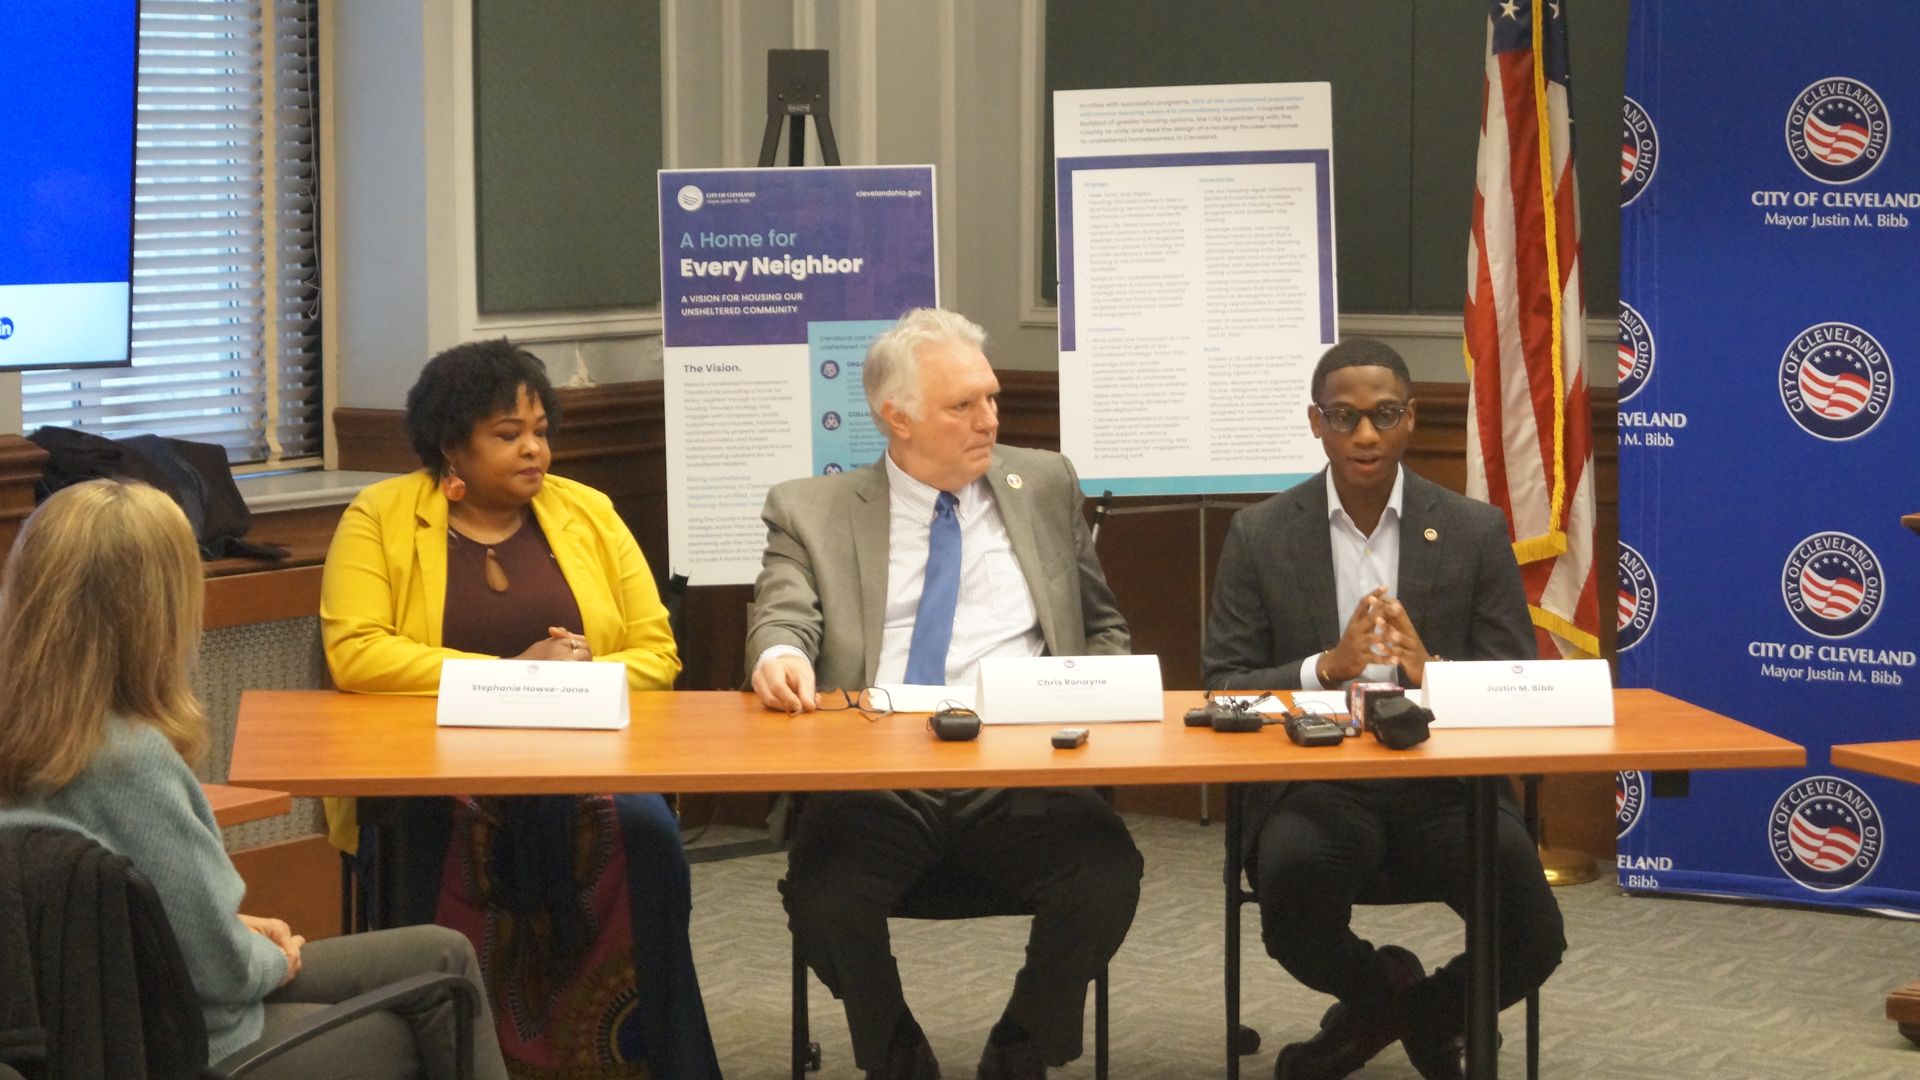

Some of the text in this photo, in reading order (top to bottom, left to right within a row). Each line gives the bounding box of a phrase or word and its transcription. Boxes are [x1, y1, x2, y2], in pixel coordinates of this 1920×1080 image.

[1791, 82, 1884, 160] CITY OF CLEVELAND OHIO
[1634, 139, 1653, 182] OHIO
[1751, 191, 1920, 208] CITY OF CLEVELAND
[1764, 212, 1908, 230] Mayor Justin M. Bibb
[680, 229, 797, 248] A Home for
[680, 254, 863, 282] Every Neighbor
[690, 295, 720, 303] VISION
[722, 294, 739, 302] FOR
[741, 293, 782, 302] HOUSING
[784, 293, 803, 302] OUR
[681, 305, 798, 316] UNSHELTERED COMMUNITY
[683, 363, 741, 373] The Vision.
[1633, 341, 1649, 380] OHIO
[1783, 328, 1887, 415] CITY OF CLEVELAND OHIO
[1618, 412, 1687, 428] EVELAND
[1624, 433, 1641, 446] M.
[1645, 433, 1674, 447] Bibb
[1787, 537, 1878, 616] CITY OF CLEVELAND OHIO
[1633, 587, 1651, 630] OHIO
[1748, 641, 1917, 667] CITY OF CLEVELAND
[1760, 664, 1902, 685] Mayor Justin M. Bibb
[471, 683, 521, 693] Stephanie
[1486, 684, 1516, 692] Justin
[1531, 684, 1554, 692] Bibb
[1621, 785, 1638, 823] OHIO
[1773, 781, 1877, 869] CITY OF CLEVELAND OHIO
[1617, 854, 1673, 872] ELAND
[1628, 875, 1658, 889] Bibb
